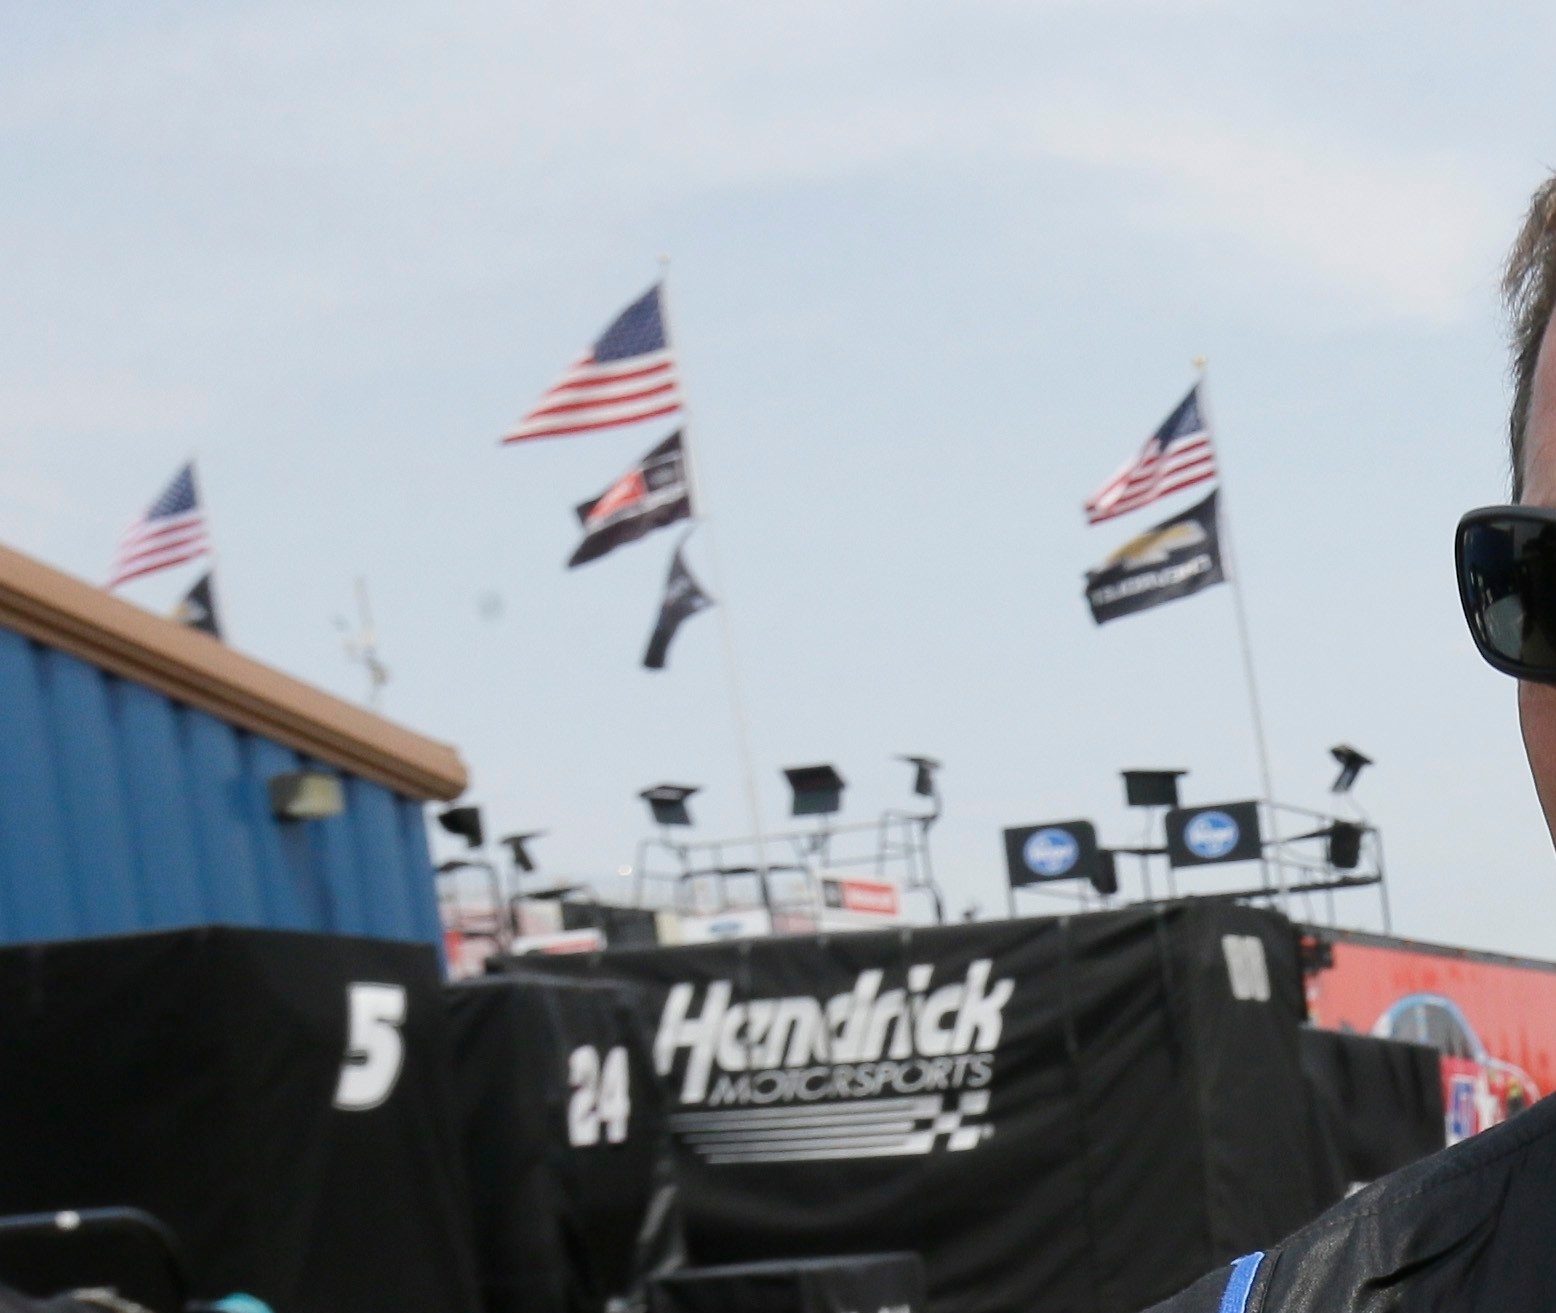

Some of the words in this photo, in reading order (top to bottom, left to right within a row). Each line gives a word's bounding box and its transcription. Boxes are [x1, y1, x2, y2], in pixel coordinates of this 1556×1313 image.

[332, 980, 407, 1112] 5
[567, 1044, 630, 1148] 24
[653, 957, 1015, 1104] Hendrick
